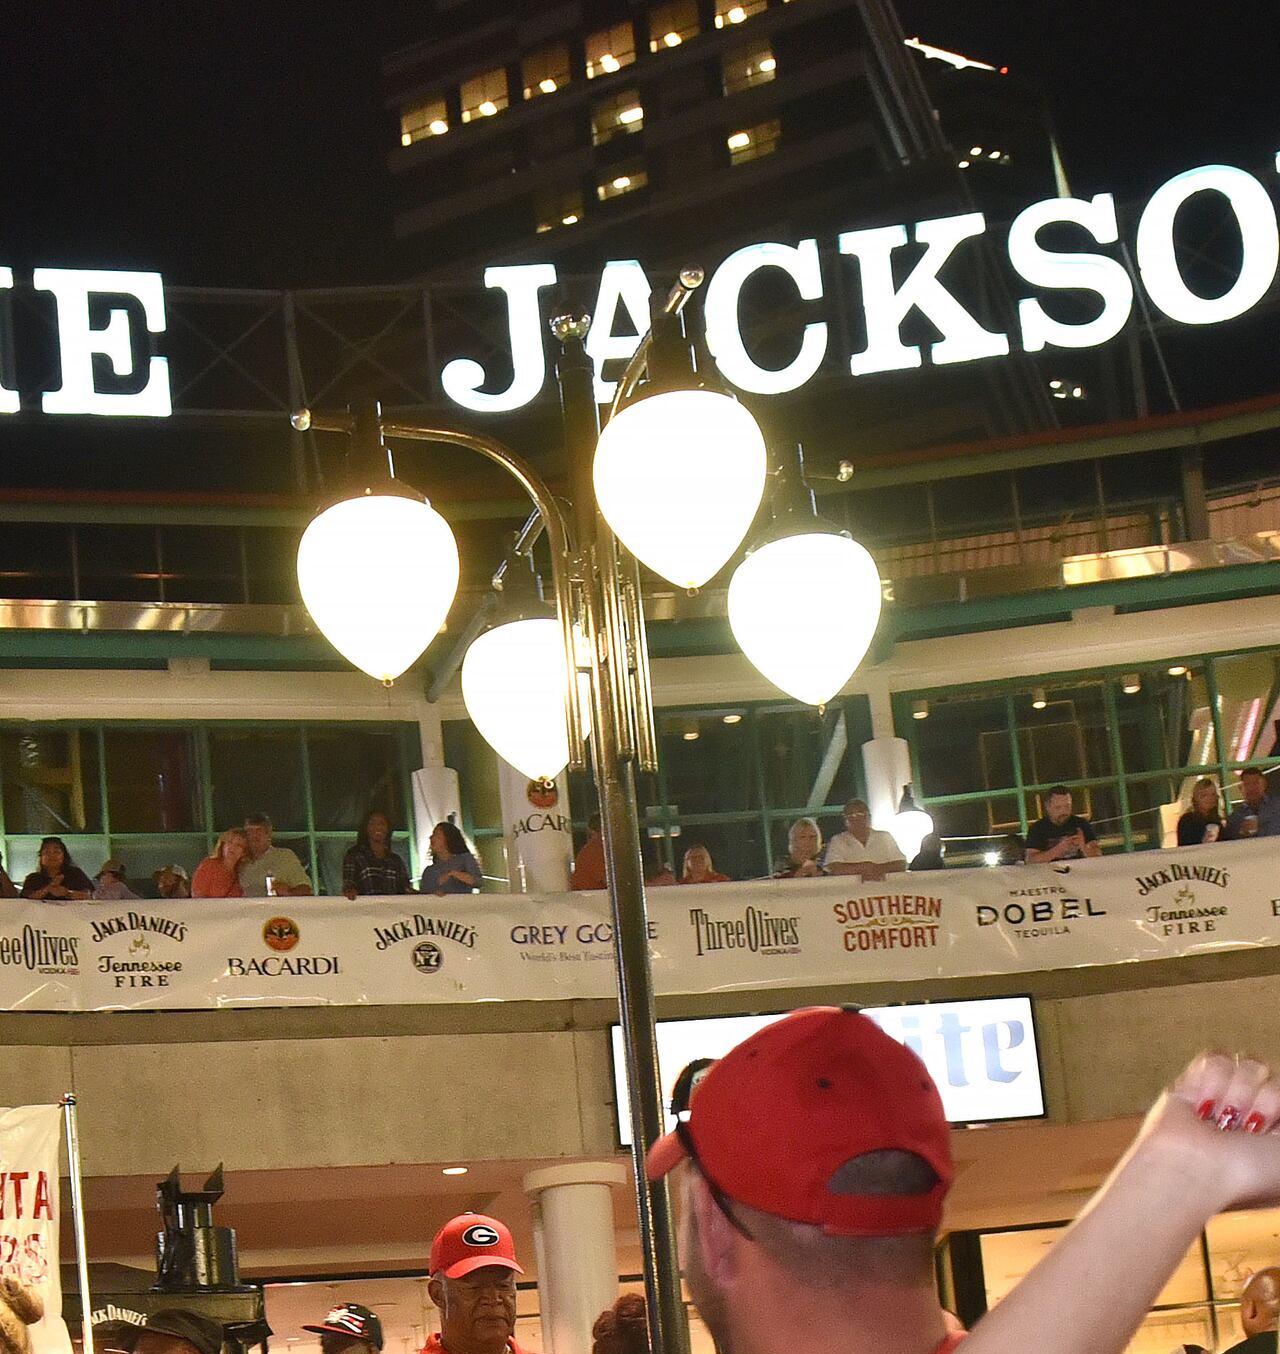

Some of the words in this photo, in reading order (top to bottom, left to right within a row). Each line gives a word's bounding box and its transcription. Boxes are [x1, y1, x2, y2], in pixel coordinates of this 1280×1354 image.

[1009, 886, 1067, 898] MAESTRO
[1135, 867, 1172, 897] JACK
[1171, 863, 1233, 890] DANIEL'S
[833, 892, 943, 924] SOUTHERN
[976, 898, 1107, 927] DOBEL
[1146, 903, 1229, 924] Tennessee
[91, 914, 127, 943] JACK
[127, 911, 190, 943] DANIEL'S
[374, 922, 412, 951] JACK
[413, 914, 479, 949] DANIEL'S
[509, 925, 569, 945] GREY
[576, 921, 660, 944] GOE
[843, 924, 940, 953] COMFORT
[1014, 926, 1071, 939] TEQUILA
[1163, 919, 1217, 937] FIRE
[98, 955, 183, 974] Tennessee
[227, 956, 340, 977] BACARDI
[115, 974, 171, 988] FIRE
[870, 1011, 1026, 1089] ite
